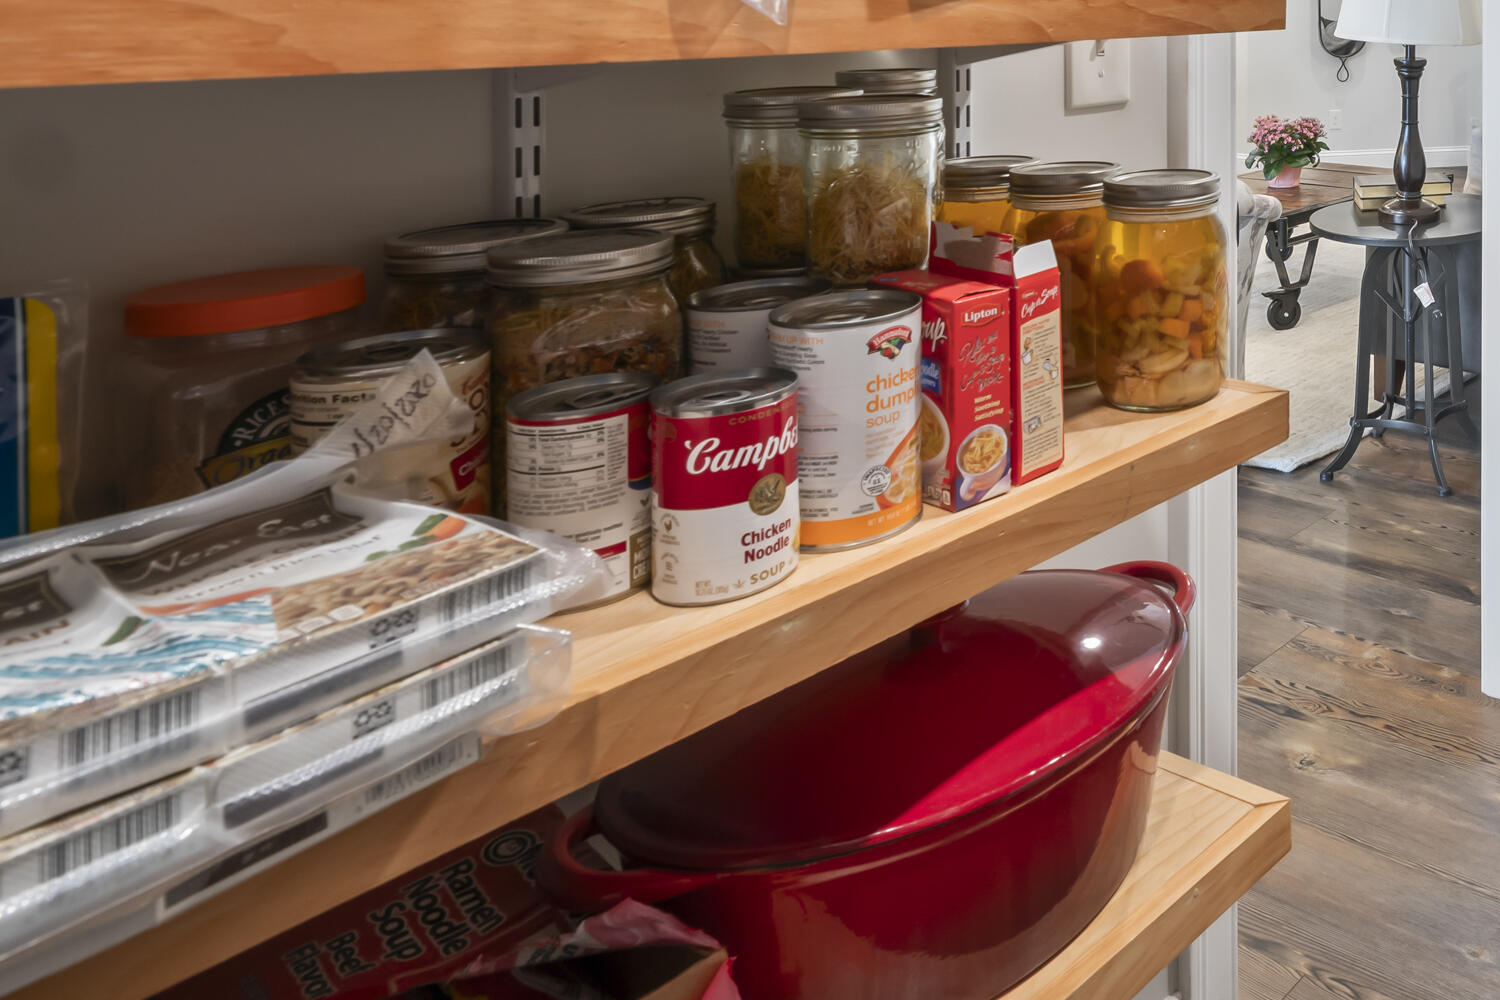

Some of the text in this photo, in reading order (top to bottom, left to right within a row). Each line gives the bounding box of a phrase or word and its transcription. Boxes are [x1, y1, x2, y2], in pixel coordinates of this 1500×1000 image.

[964, 306, 998, 324] Lipton
[921, 360, 940, 380] oodle
[866, 410, 901, 429] soup
[684, 415, 799, 476] Campbe
[741, 517, 792, 547] Chicken
[744, 535, 790, 564] Noodle
[750, 560, 786, 585] SOUP
[402, 873, 471, 957] Noodle
[437, 857, 505, 934] Ramen
[366, 901, 424, 961] Soup
[282, 938, 337, 1000] Flavor
[322, 930, 376, 979] Beef
